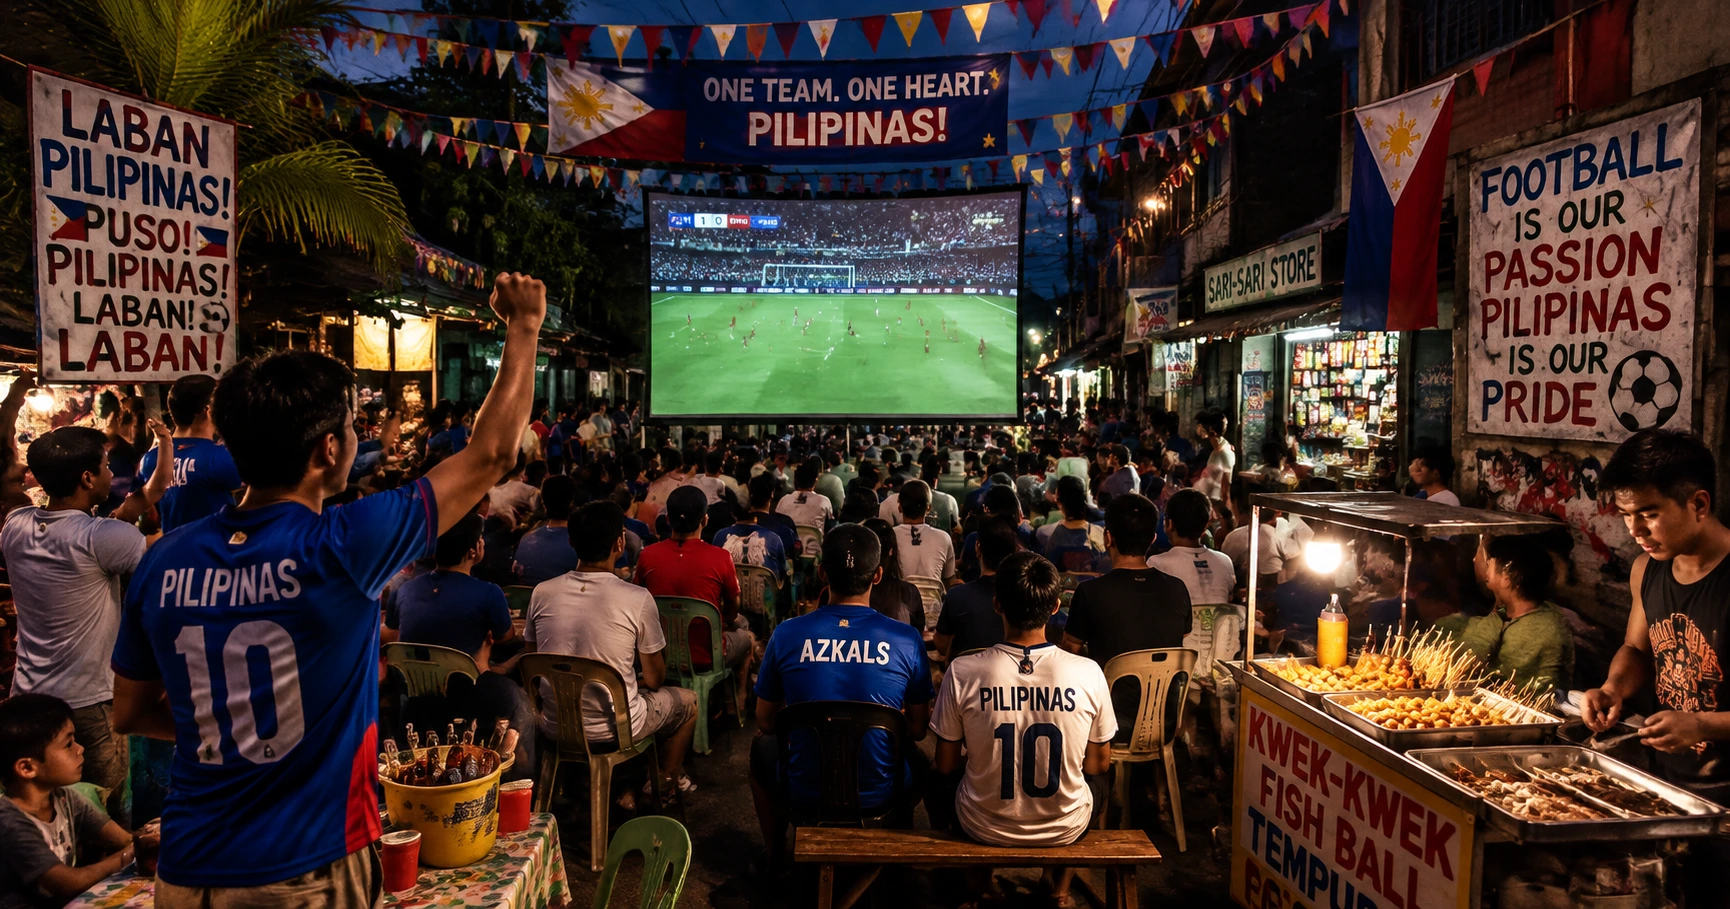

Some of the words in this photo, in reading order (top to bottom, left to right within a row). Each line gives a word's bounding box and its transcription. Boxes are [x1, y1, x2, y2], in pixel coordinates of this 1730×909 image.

[703, 76, 754, 102] ONE
[762, 77, 839, 102] TEAM.
[847, 75, 897, 100] ONE
[904, 70, 988, 98] HEART.
[63, 89, 210, 168] LABAN
[749, 107, 947, 146] PILIPINAS!
[40, 138, 231, 220] PILIPINAS!
[1480, 122, 1683, 213] FOOTBALL
[84, 203, 191, 256] PUSO!
[715, 216, 722, 225] 0
[1515, 208, 1542, 242] IS
[1558, 190, 1626, 233] OUR
[45, 243, 230, 299] PILIPINAS!
[1208, 264, 1265, 304] SARI-SARI
[1270, 245, 1316, 289] STORE
[1484, 226, 1663, 293] PASSION
[73, 291, 195, 331] LABAN!
[1480, 282, 1672, 340] PILIPINAS
[58, 328, 225, 373] LABAN!
[1508, 343, 1535, 375] IS
[1550, 341, 1609, 374] OUR
[1482, 379, 1597, 427] PRIDE
[159, 558, 301, 608] PILIPINAS
[800, 638, 890, 665] AZKALS
[174, 619, 305, 765] 10
[980, 686, 1076, 712] PILIPINAS
[994, 722, 1063, 800] 10
[1248, 706, 1456, 881] KWEK-KWEK
[1248, 805, 1380, 909] TEMPU
[1260, 763, 1325, 849] FISH
[1334, 815, 1422, 909] BALL
